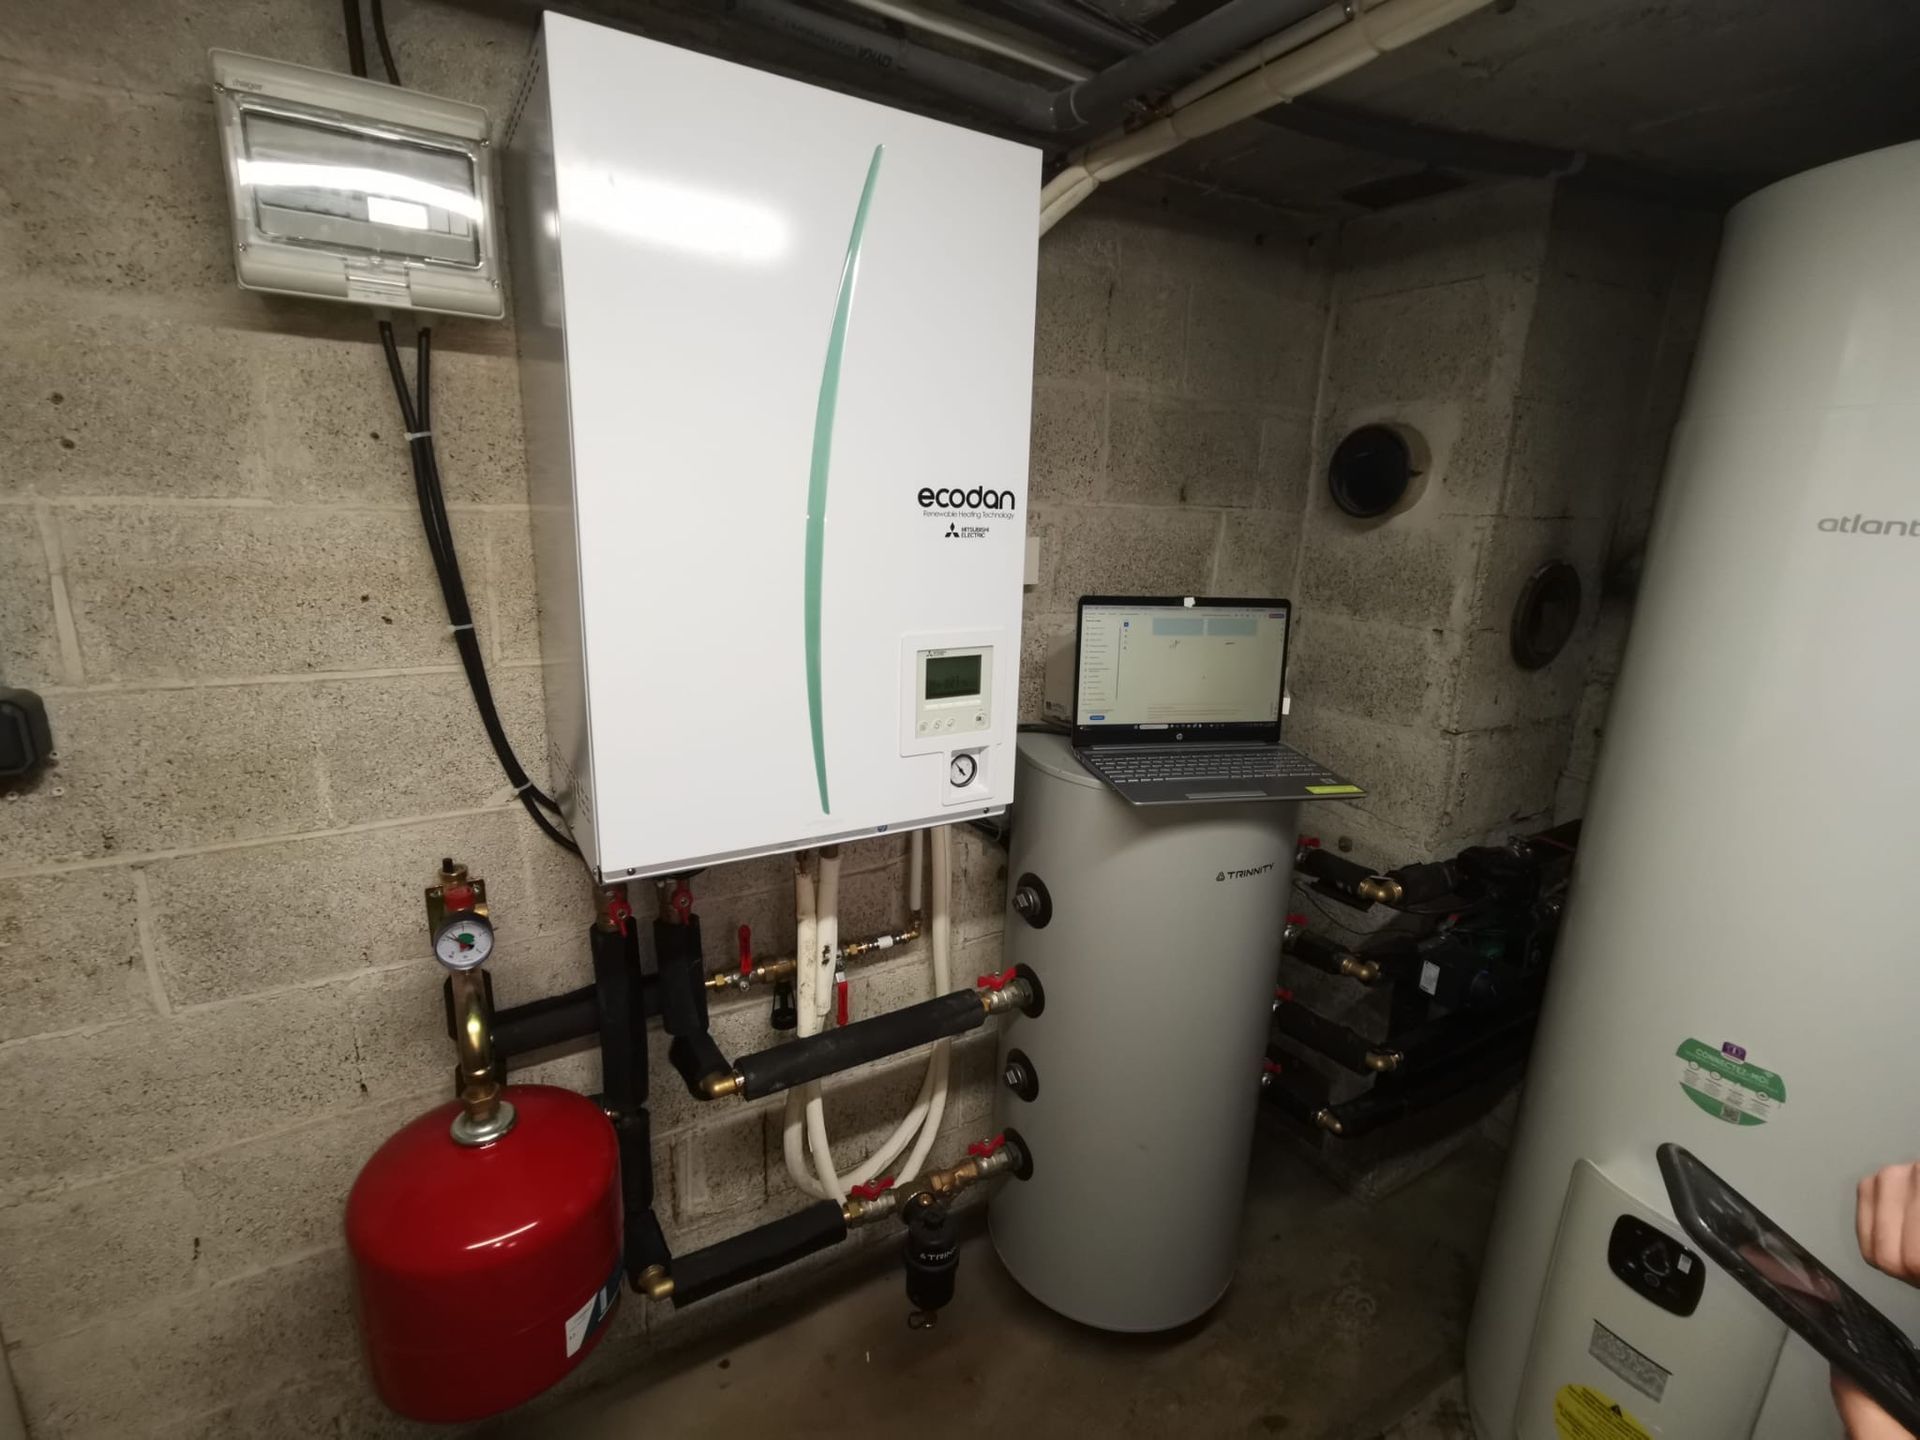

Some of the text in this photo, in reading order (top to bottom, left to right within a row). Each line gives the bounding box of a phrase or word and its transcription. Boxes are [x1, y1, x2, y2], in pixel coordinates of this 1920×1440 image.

[918, 485, 1015, 510] ecodan
[923, 510, 1015, 520] Renewable Heating Technology
[1227, 862, 1275, 879] TRINNITY
